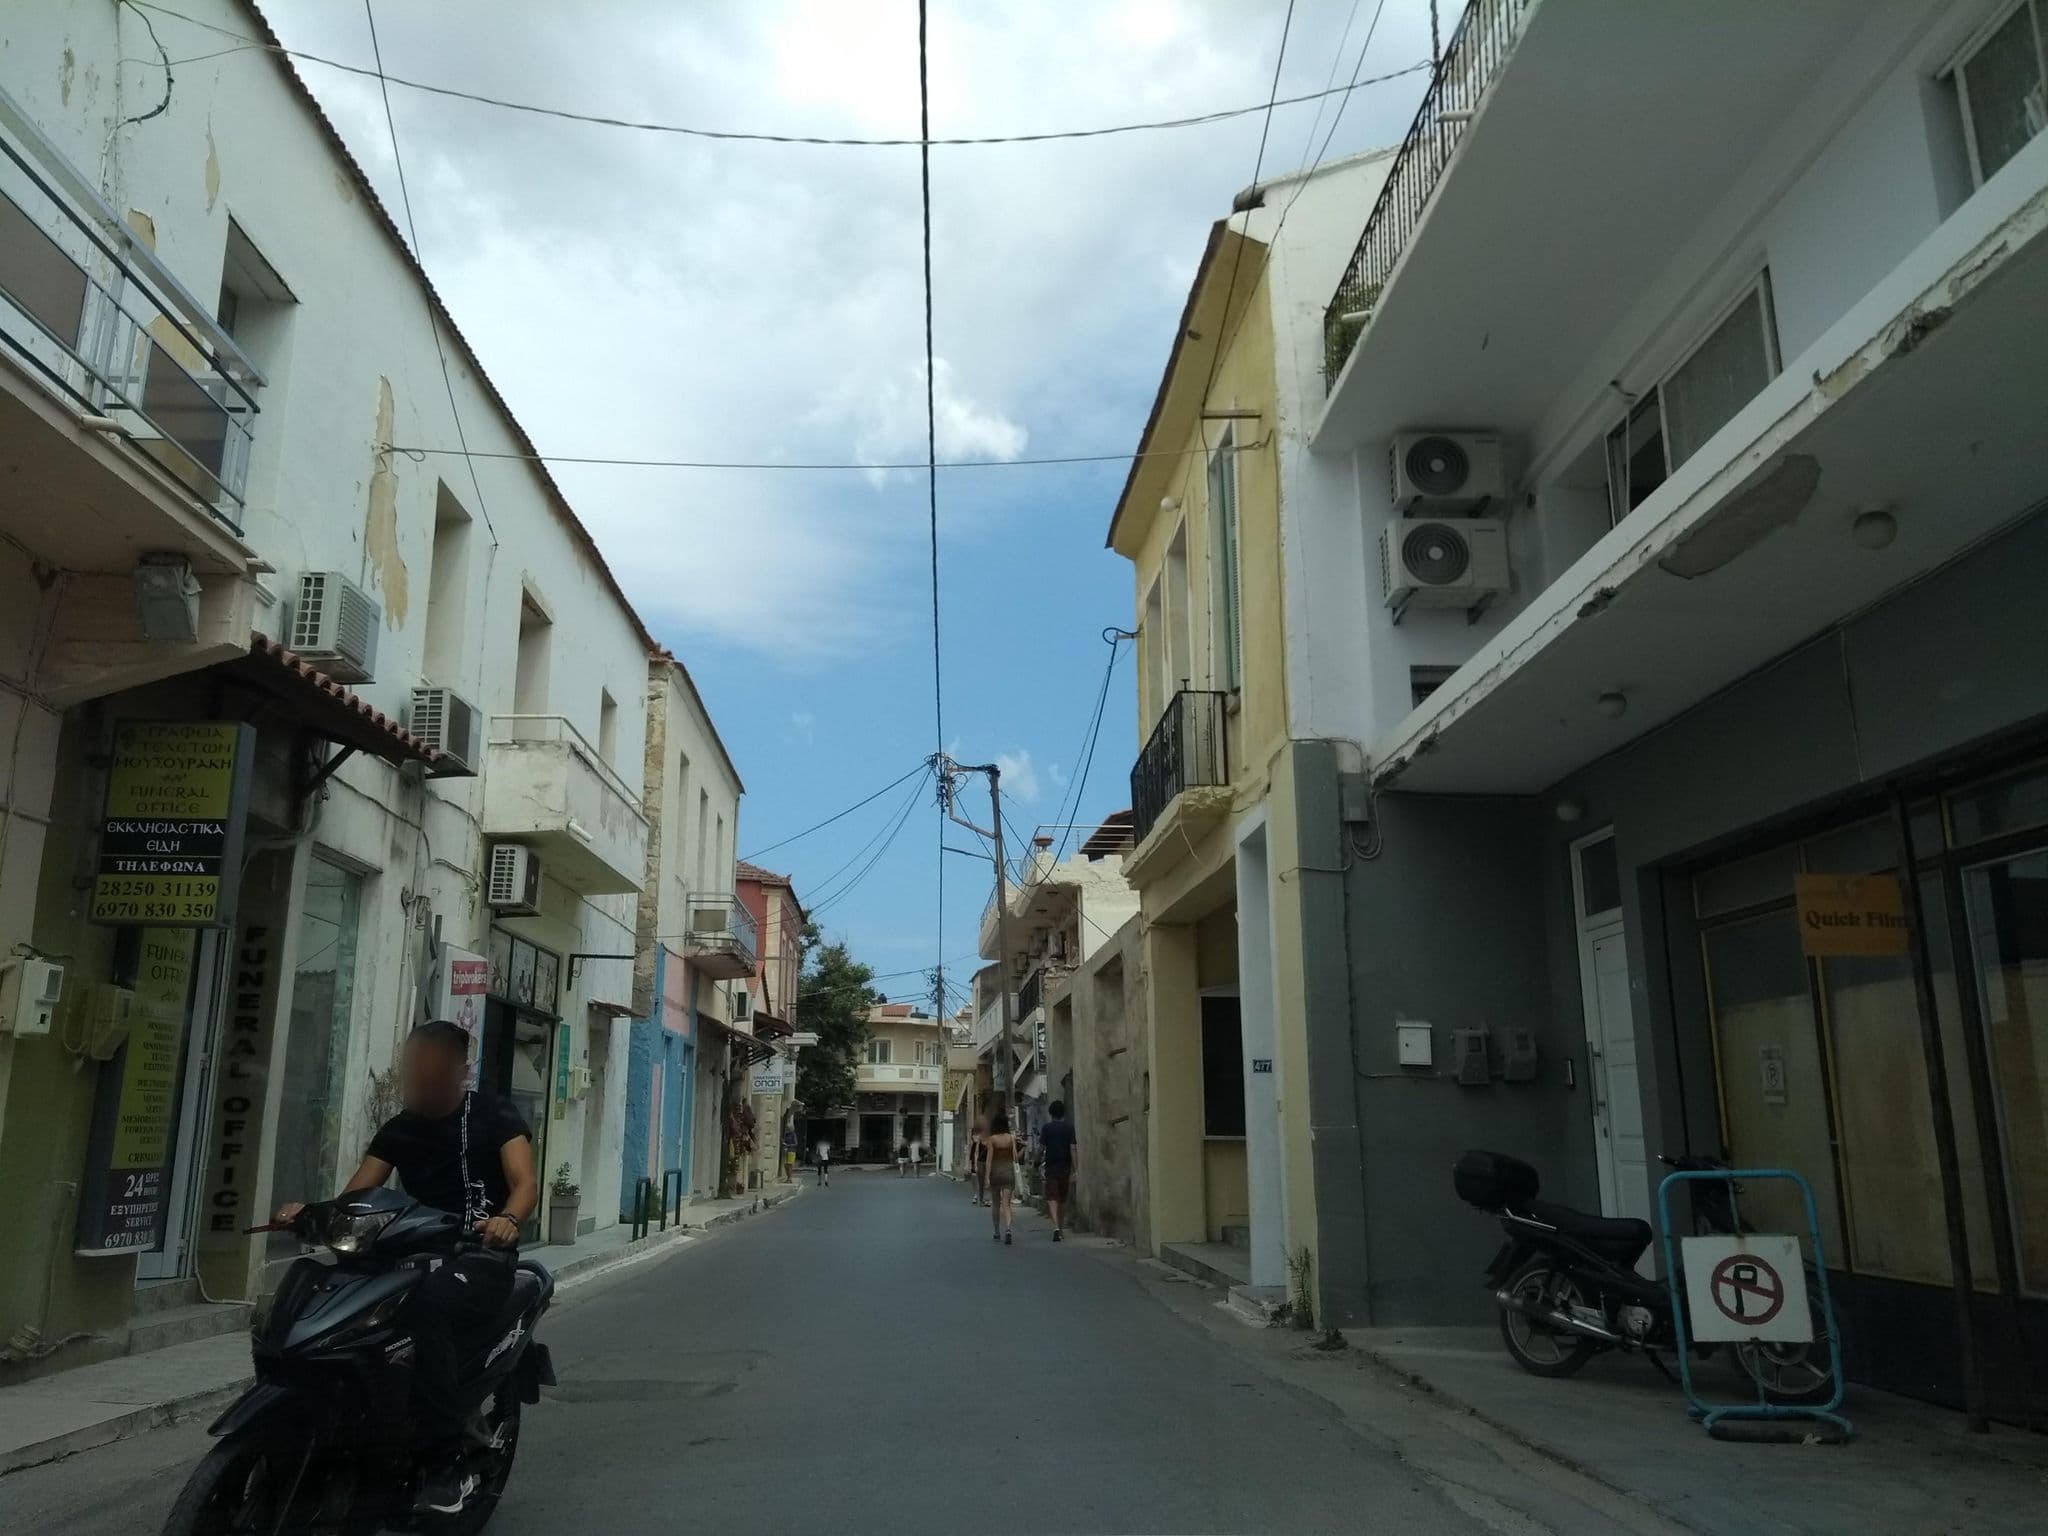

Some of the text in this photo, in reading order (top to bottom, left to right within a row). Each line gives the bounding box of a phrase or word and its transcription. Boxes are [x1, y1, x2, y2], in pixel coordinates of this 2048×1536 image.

[136, 802, 200, 813] OFFICE
[116, 860, 205, 873] ΤΗΛΕΦΩΝΑ
[99, 881, 216, 897] 28250 31139
[96, 902, 213, 918] 6970 830 350
[1806, 910, 1860, 930] Quick
[210, 926, 268, 1233] FUNERAL OFFICE
[123, 1174, 144, 1198] 24
[385, 1336, 412, 1353] HONDA
